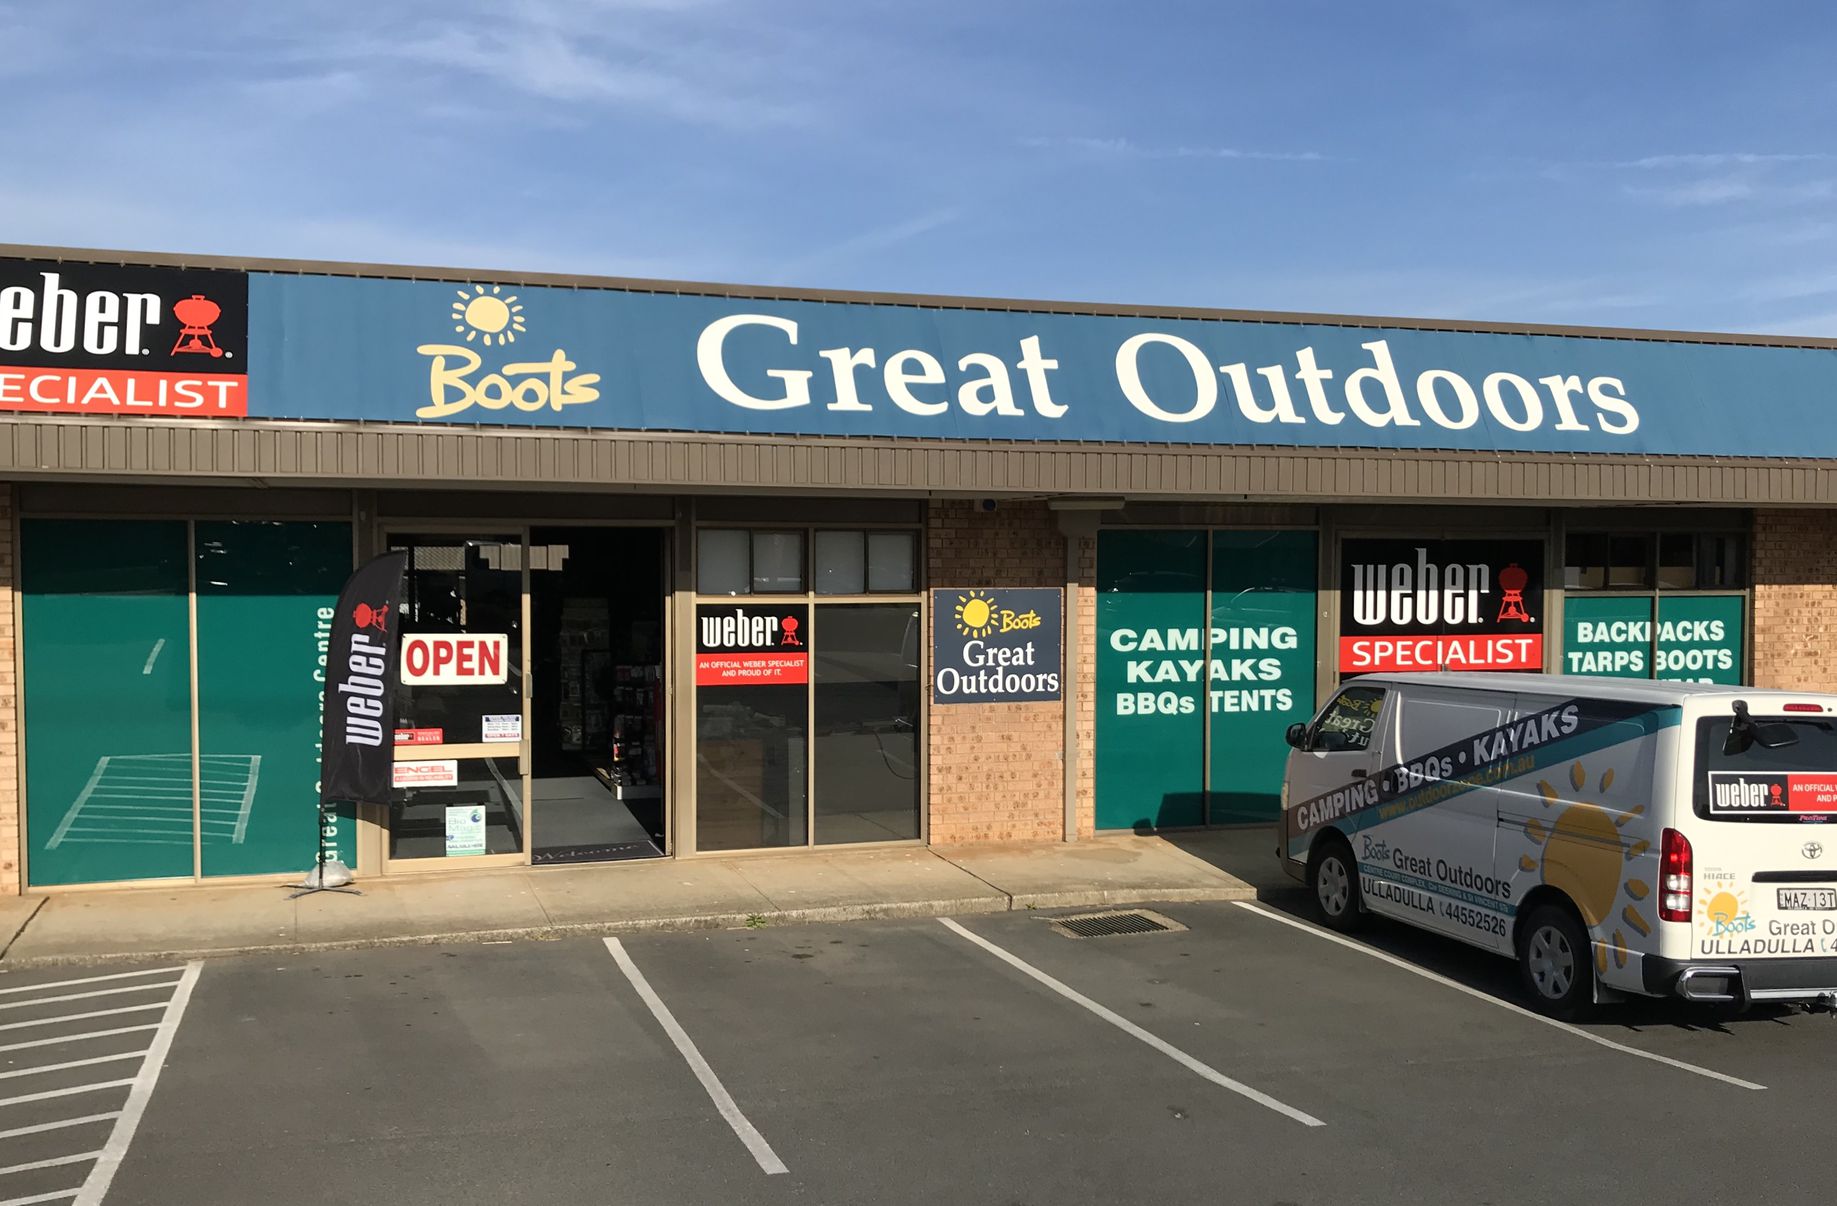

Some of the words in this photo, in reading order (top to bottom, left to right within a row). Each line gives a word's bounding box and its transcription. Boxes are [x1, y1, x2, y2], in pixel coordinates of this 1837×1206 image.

[415, 343, 601, 419] Boots
[696, 314, 1069, 419] Great
[1115, 332, 1640, 435] Outdoors
[1351, 547, 1490, 626] weber
[701, 608, 779, 648] weber
[1000, 609, 1042, 633] Boots
[1577, 620, 1725, 644] BACKPACKS
[1110, 626, 1298, 652] CAMPING
[1352, 638, 1534, 667] SPECIALIST
[405, 639, 501, 677] OPEN
[699, 661, 709, 669] AN
[710, 660, 741, 669] OFFICIAL
[743, 660, 766, 668] WEBER
[768, 659, 804, 667] SPECIALIST
[962, 640, 1036, 667] Great
[1568, 650, 1643, 673] TARPS
[1655, 648, 1733, 672] BOOTS
[722, 669, 737, 677] AND
[738, 669, 762, 677] PROUD
[763, 668, 772, 676] OF
[937, 666, 1060, 695] Outdoors
[1127, 658, 1282, 684] KAYAKS
[338, 633, 387, 747] weber
[1116, 691, 1196, 715] BBQs
[1210, 688, 1293, 712] TENTS
[395, 765, 454, 774] ENGEL
[1297, 779, 1379, 831] CAMPING
[1395, 755, 1453, 794] BBQs
[1473, 705, 1579, 766] KAYAKS
[1715, 777, 1769, 808] weber
[1792, 783, 1804, 792] AN
[1804, 783, 1834, 792] OFFICIAL
[1816, 794, 1832, 803] AND
[1361, 834, 1391, 862] Boots
[1392, 848, 1432, 877] Great
[1436, 859, 1511, 899] Outdoors
[1703, 872, 1736, 880] HIACE
[1362, 877, 1436, 915] ULLADULLA
[1445, 902, 1507, 937] 44552526
[1712, 911, 1756, 937] Boots
[1768, 919, 1817, 936] Great
[1700, 938, 1815, 955] ULLADULLA
